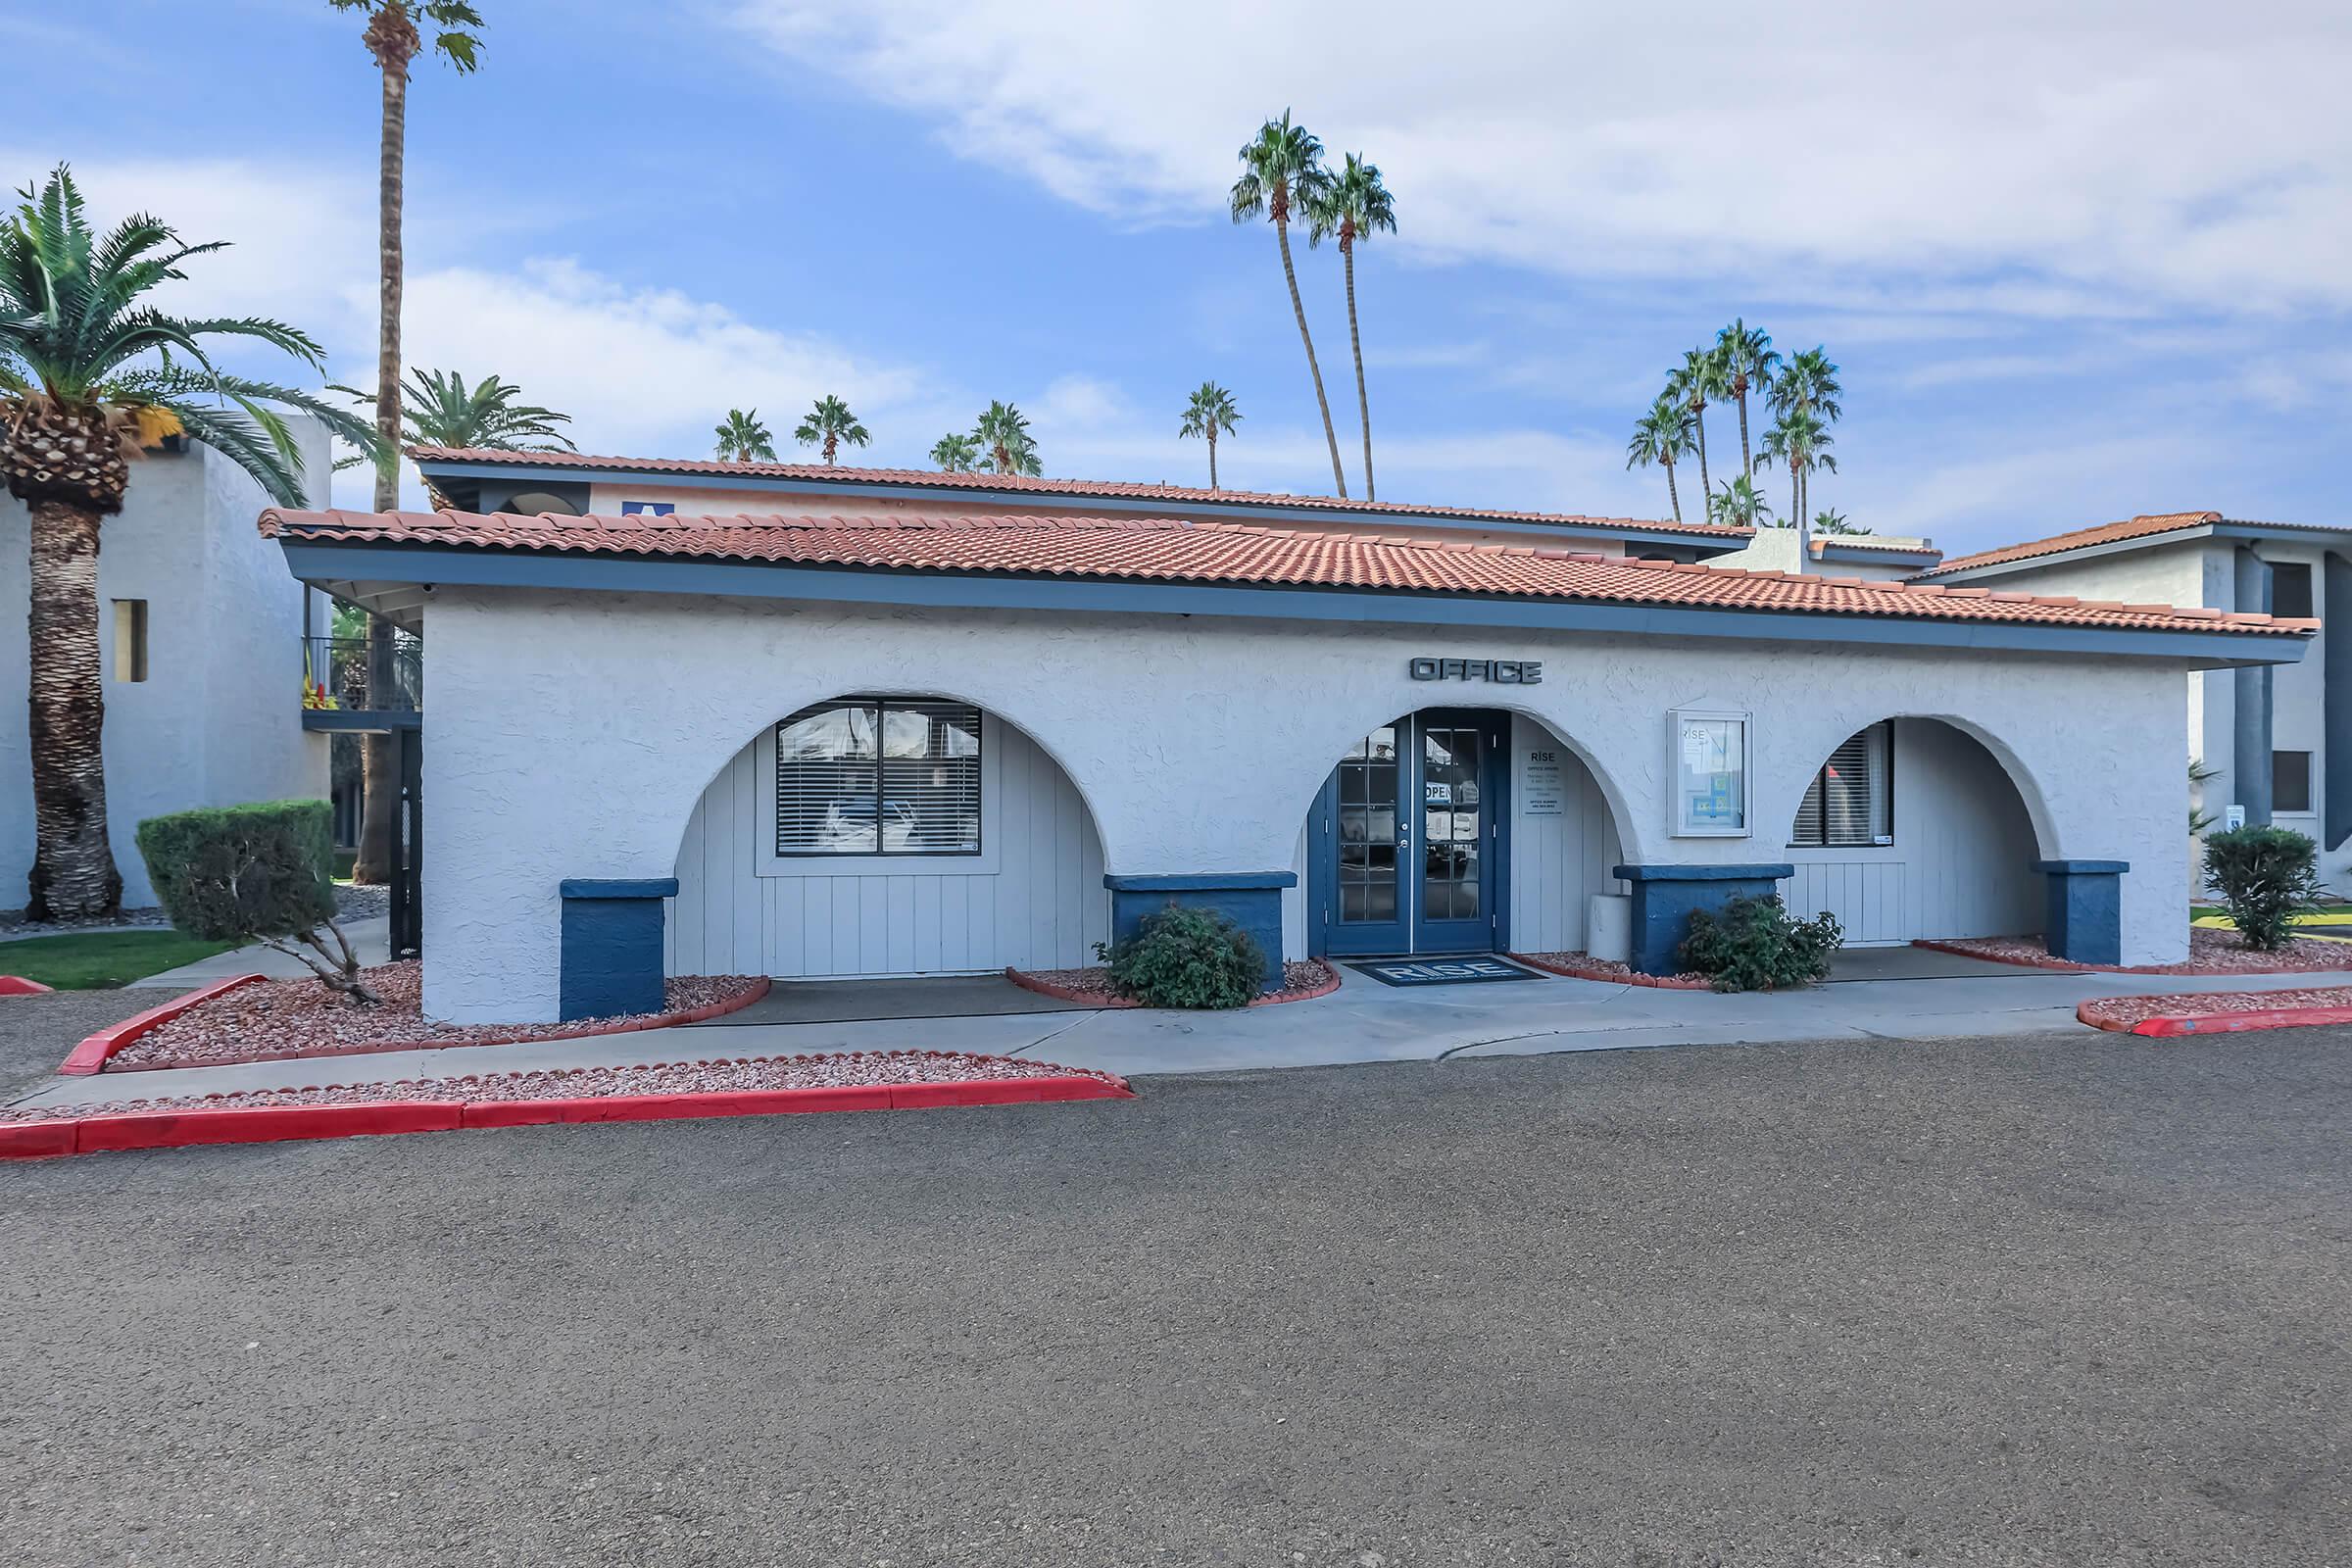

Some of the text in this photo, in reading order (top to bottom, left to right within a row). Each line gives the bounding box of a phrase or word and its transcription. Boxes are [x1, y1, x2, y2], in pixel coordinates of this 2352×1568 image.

[1410, 658, 1543, 684] OFFICE
[1531, 751, 1555, 761] RISE
[1426, 786, 1451, 799] OPEN
